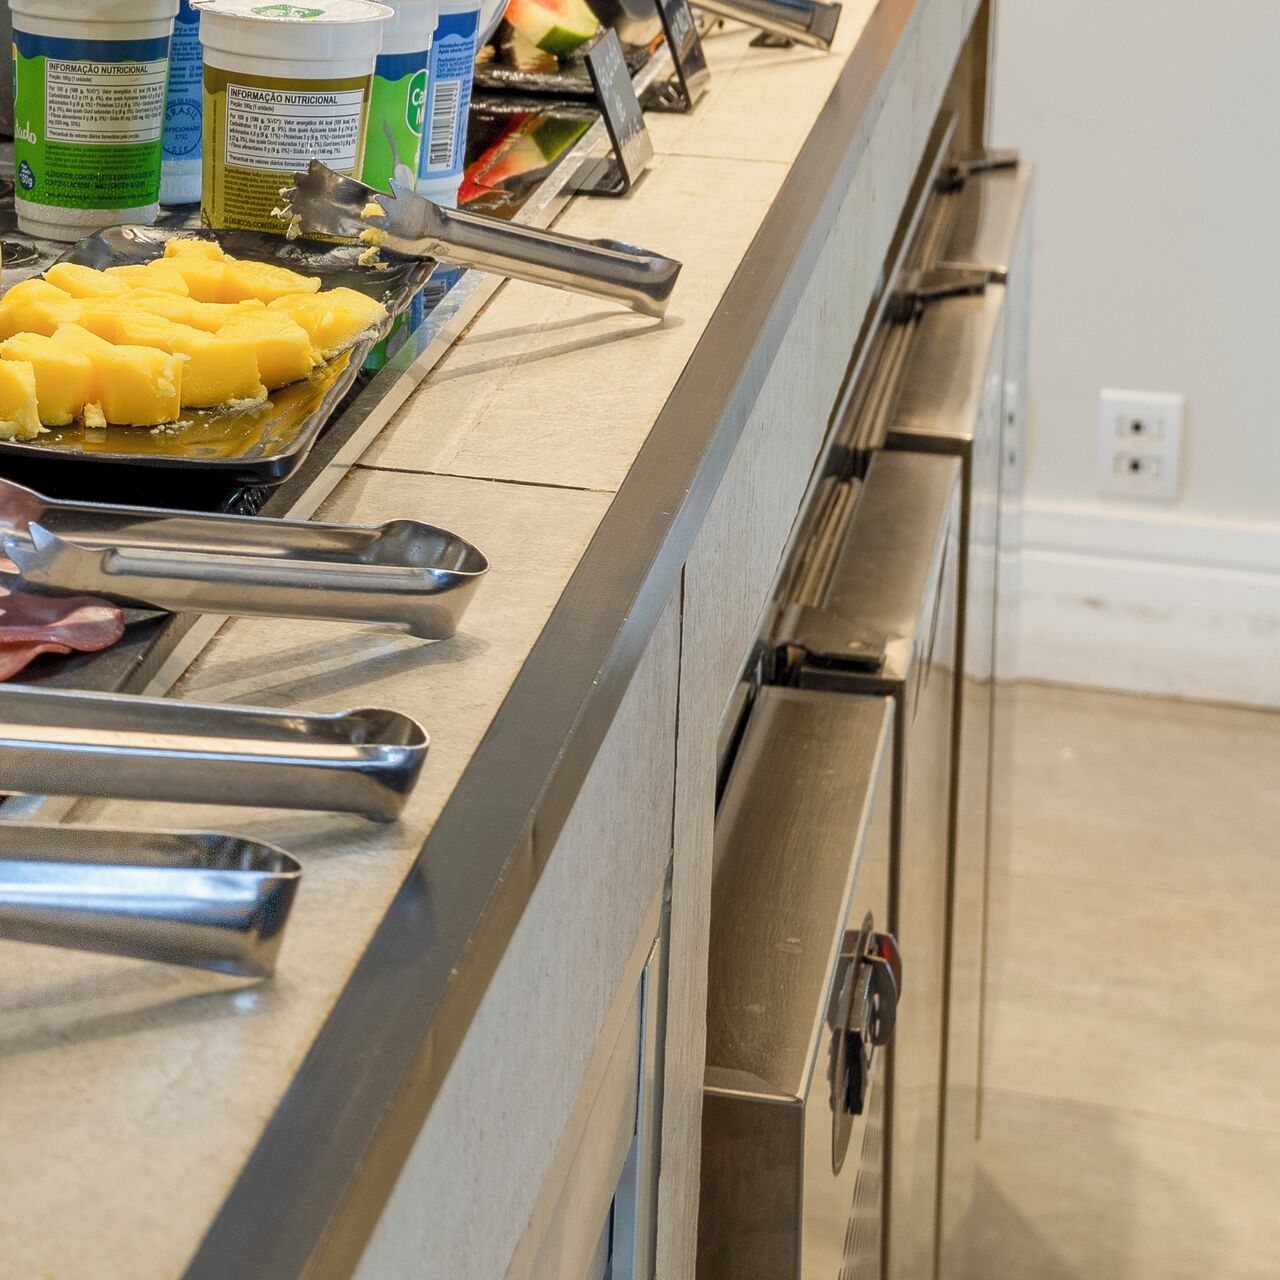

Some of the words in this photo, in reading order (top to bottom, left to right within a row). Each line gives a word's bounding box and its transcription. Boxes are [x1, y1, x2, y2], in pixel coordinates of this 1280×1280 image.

[49, 63, 99, 75] INFORMAÇÃO
[101, 66, 148, 75] NUTRICIONAL
[230, 89, 282, 103] INFORMAÇÃO
[285, 95, 338, 104] NUTRICIONAL
